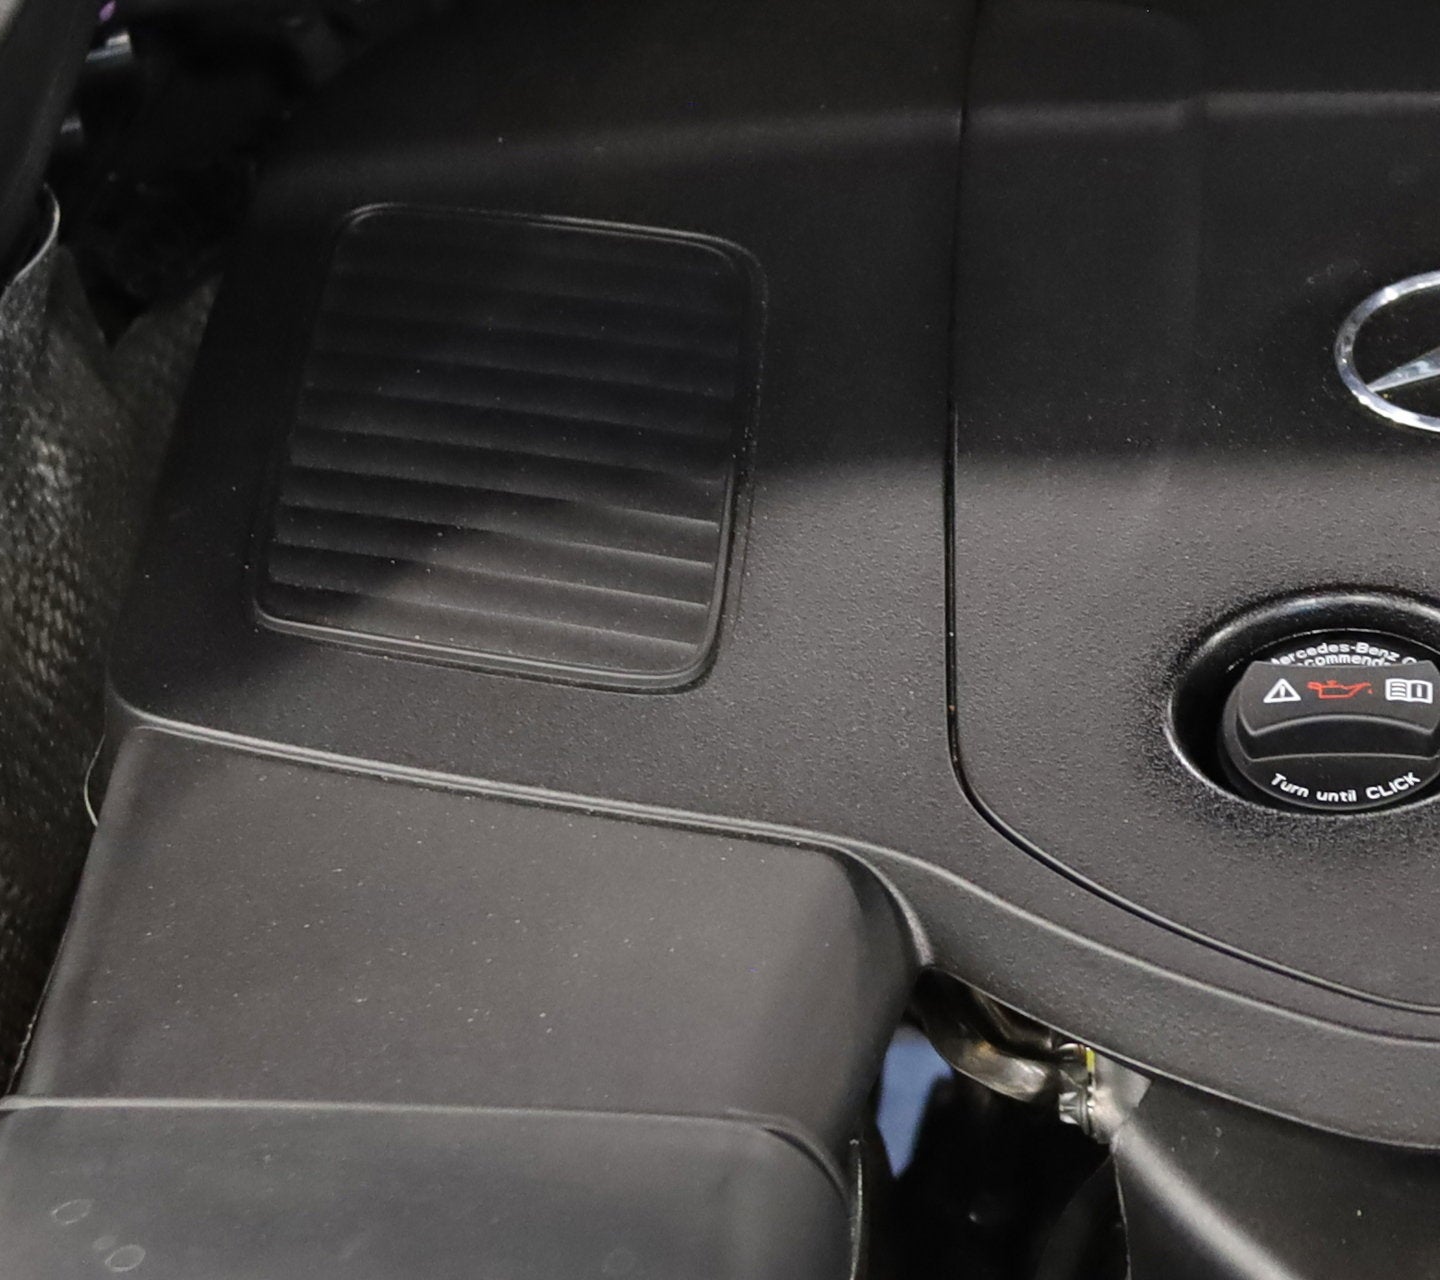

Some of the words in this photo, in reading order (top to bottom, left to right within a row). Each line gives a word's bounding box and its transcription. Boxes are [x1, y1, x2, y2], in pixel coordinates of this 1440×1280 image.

[1270, 772, 1310, 798] Turn
[1316, 789, 1357, 802] until
[1365, 771, 1421, 800] CLICK
